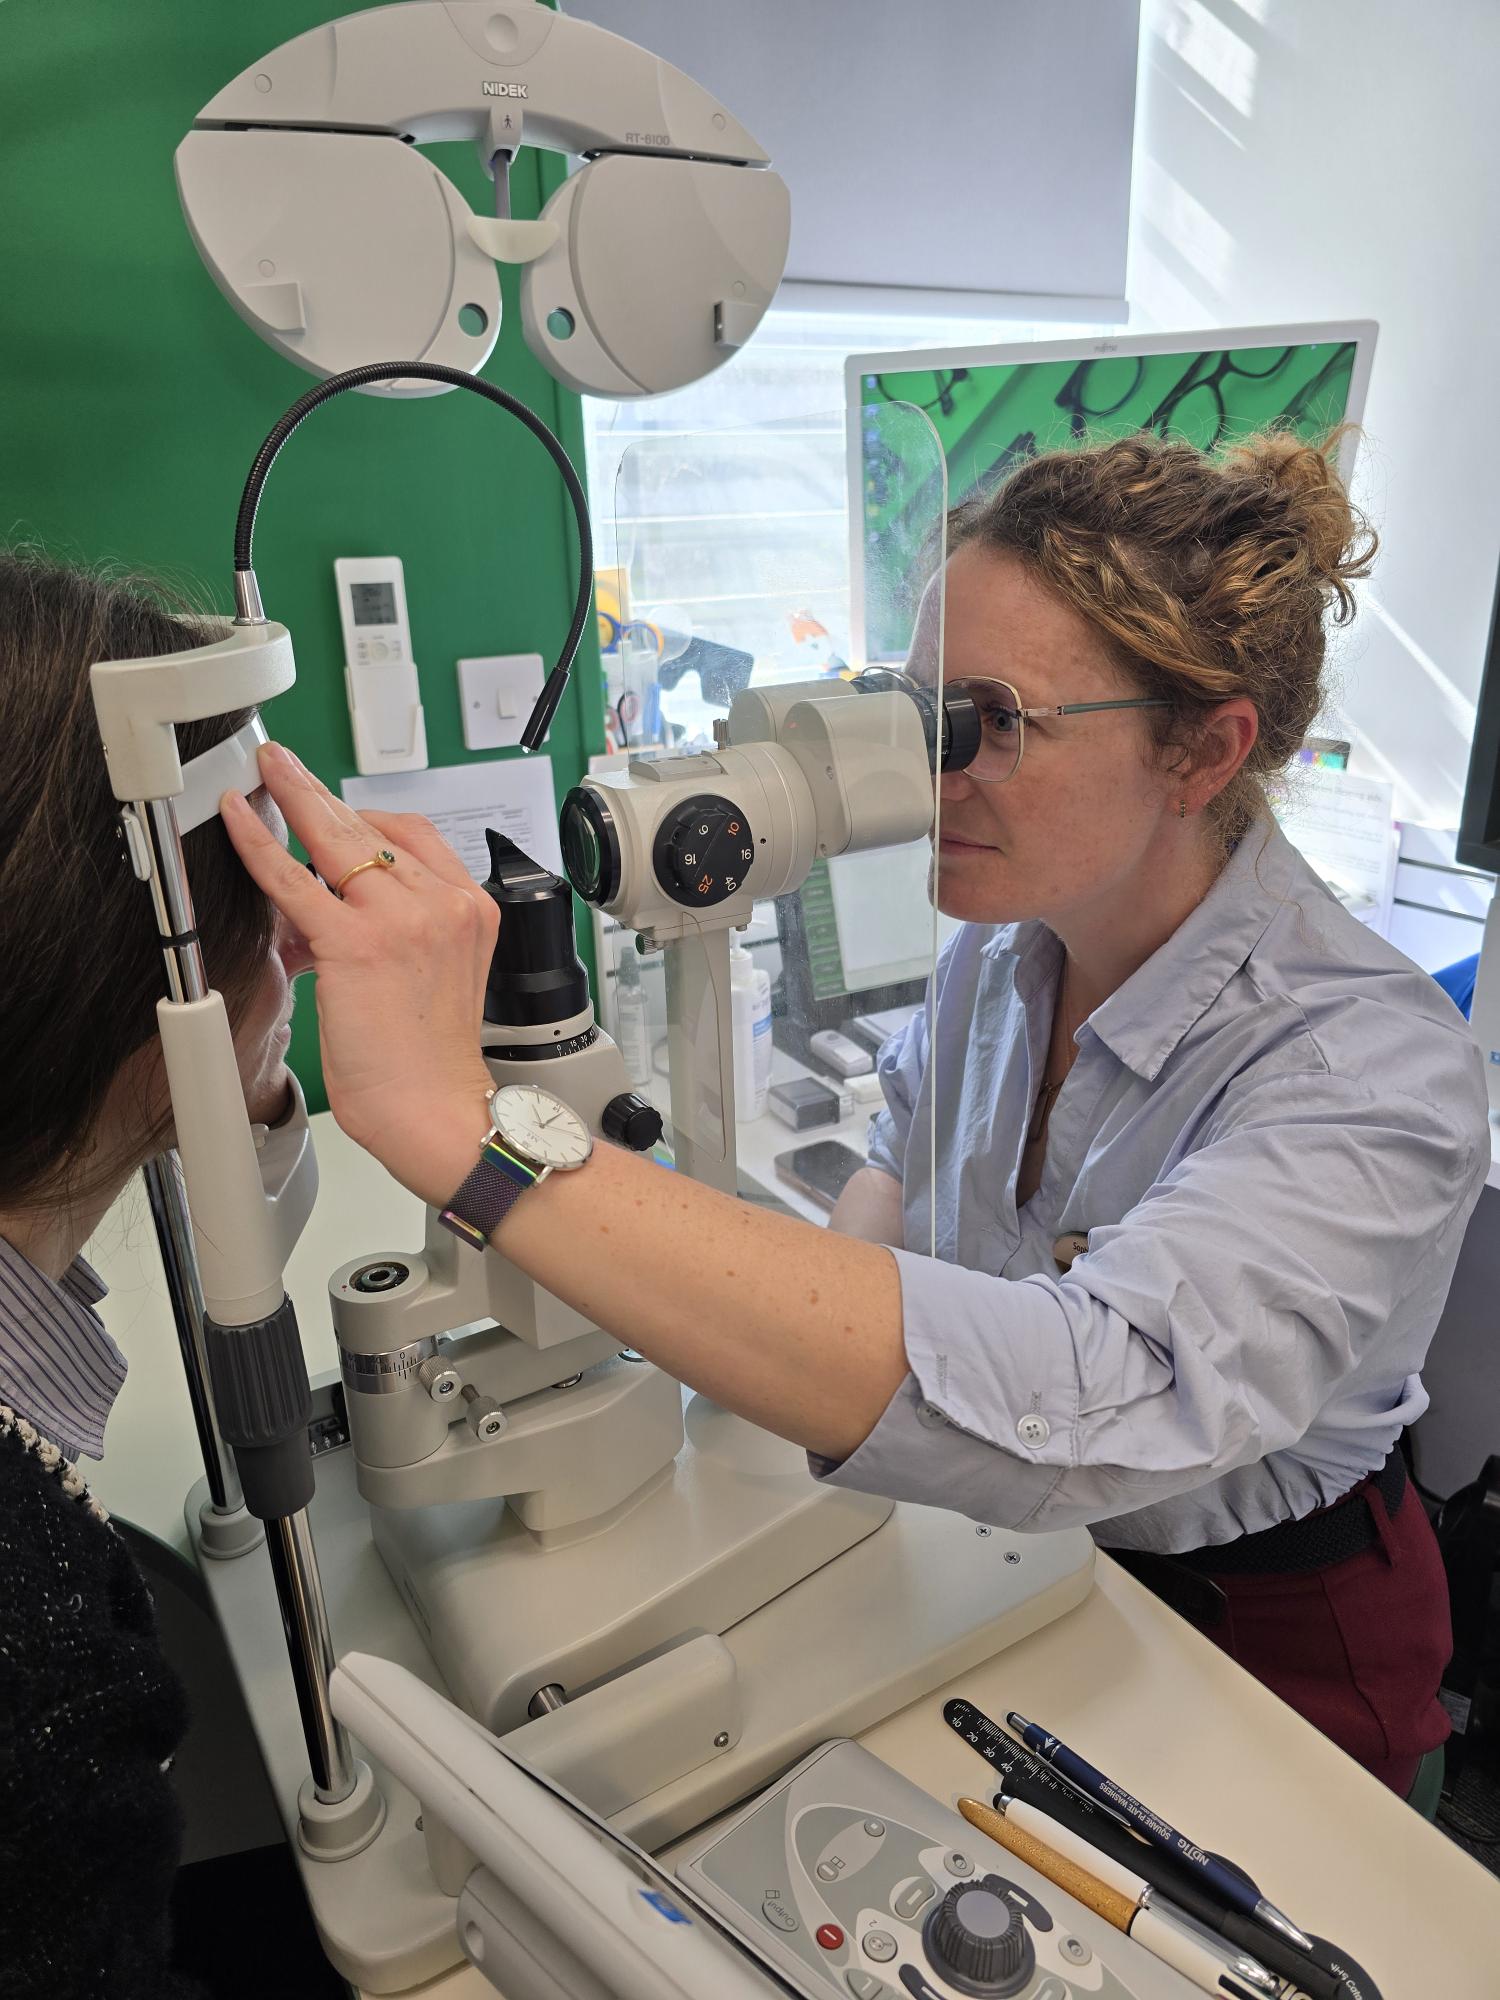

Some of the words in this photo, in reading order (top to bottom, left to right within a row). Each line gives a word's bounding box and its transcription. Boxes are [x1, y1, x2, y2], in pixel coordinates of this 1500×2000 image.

[482, 81, 528, 98] NIDEK
[625, 132, 671, 146] RT-6100
[727, 822, 740, 836] 10
[741, 848, 752, 861] 16
[698, 874, 713, 894] 25
[725, 877, 737, 891] 40
[952, 1716, 962, 1728] 10
[966, 1731, 979, 1743] 20
[983, 1746, 995, 1758] 30
[1000, 1761, 1013, 1773] 40
[1099, 1782, 1129, 1808] WASHERS
[1126, 1805, 1145, 1822] PLATE
[1144, 1816, 1171, 1840] SQUARE
[767, 1900, 796, 1927] Output
